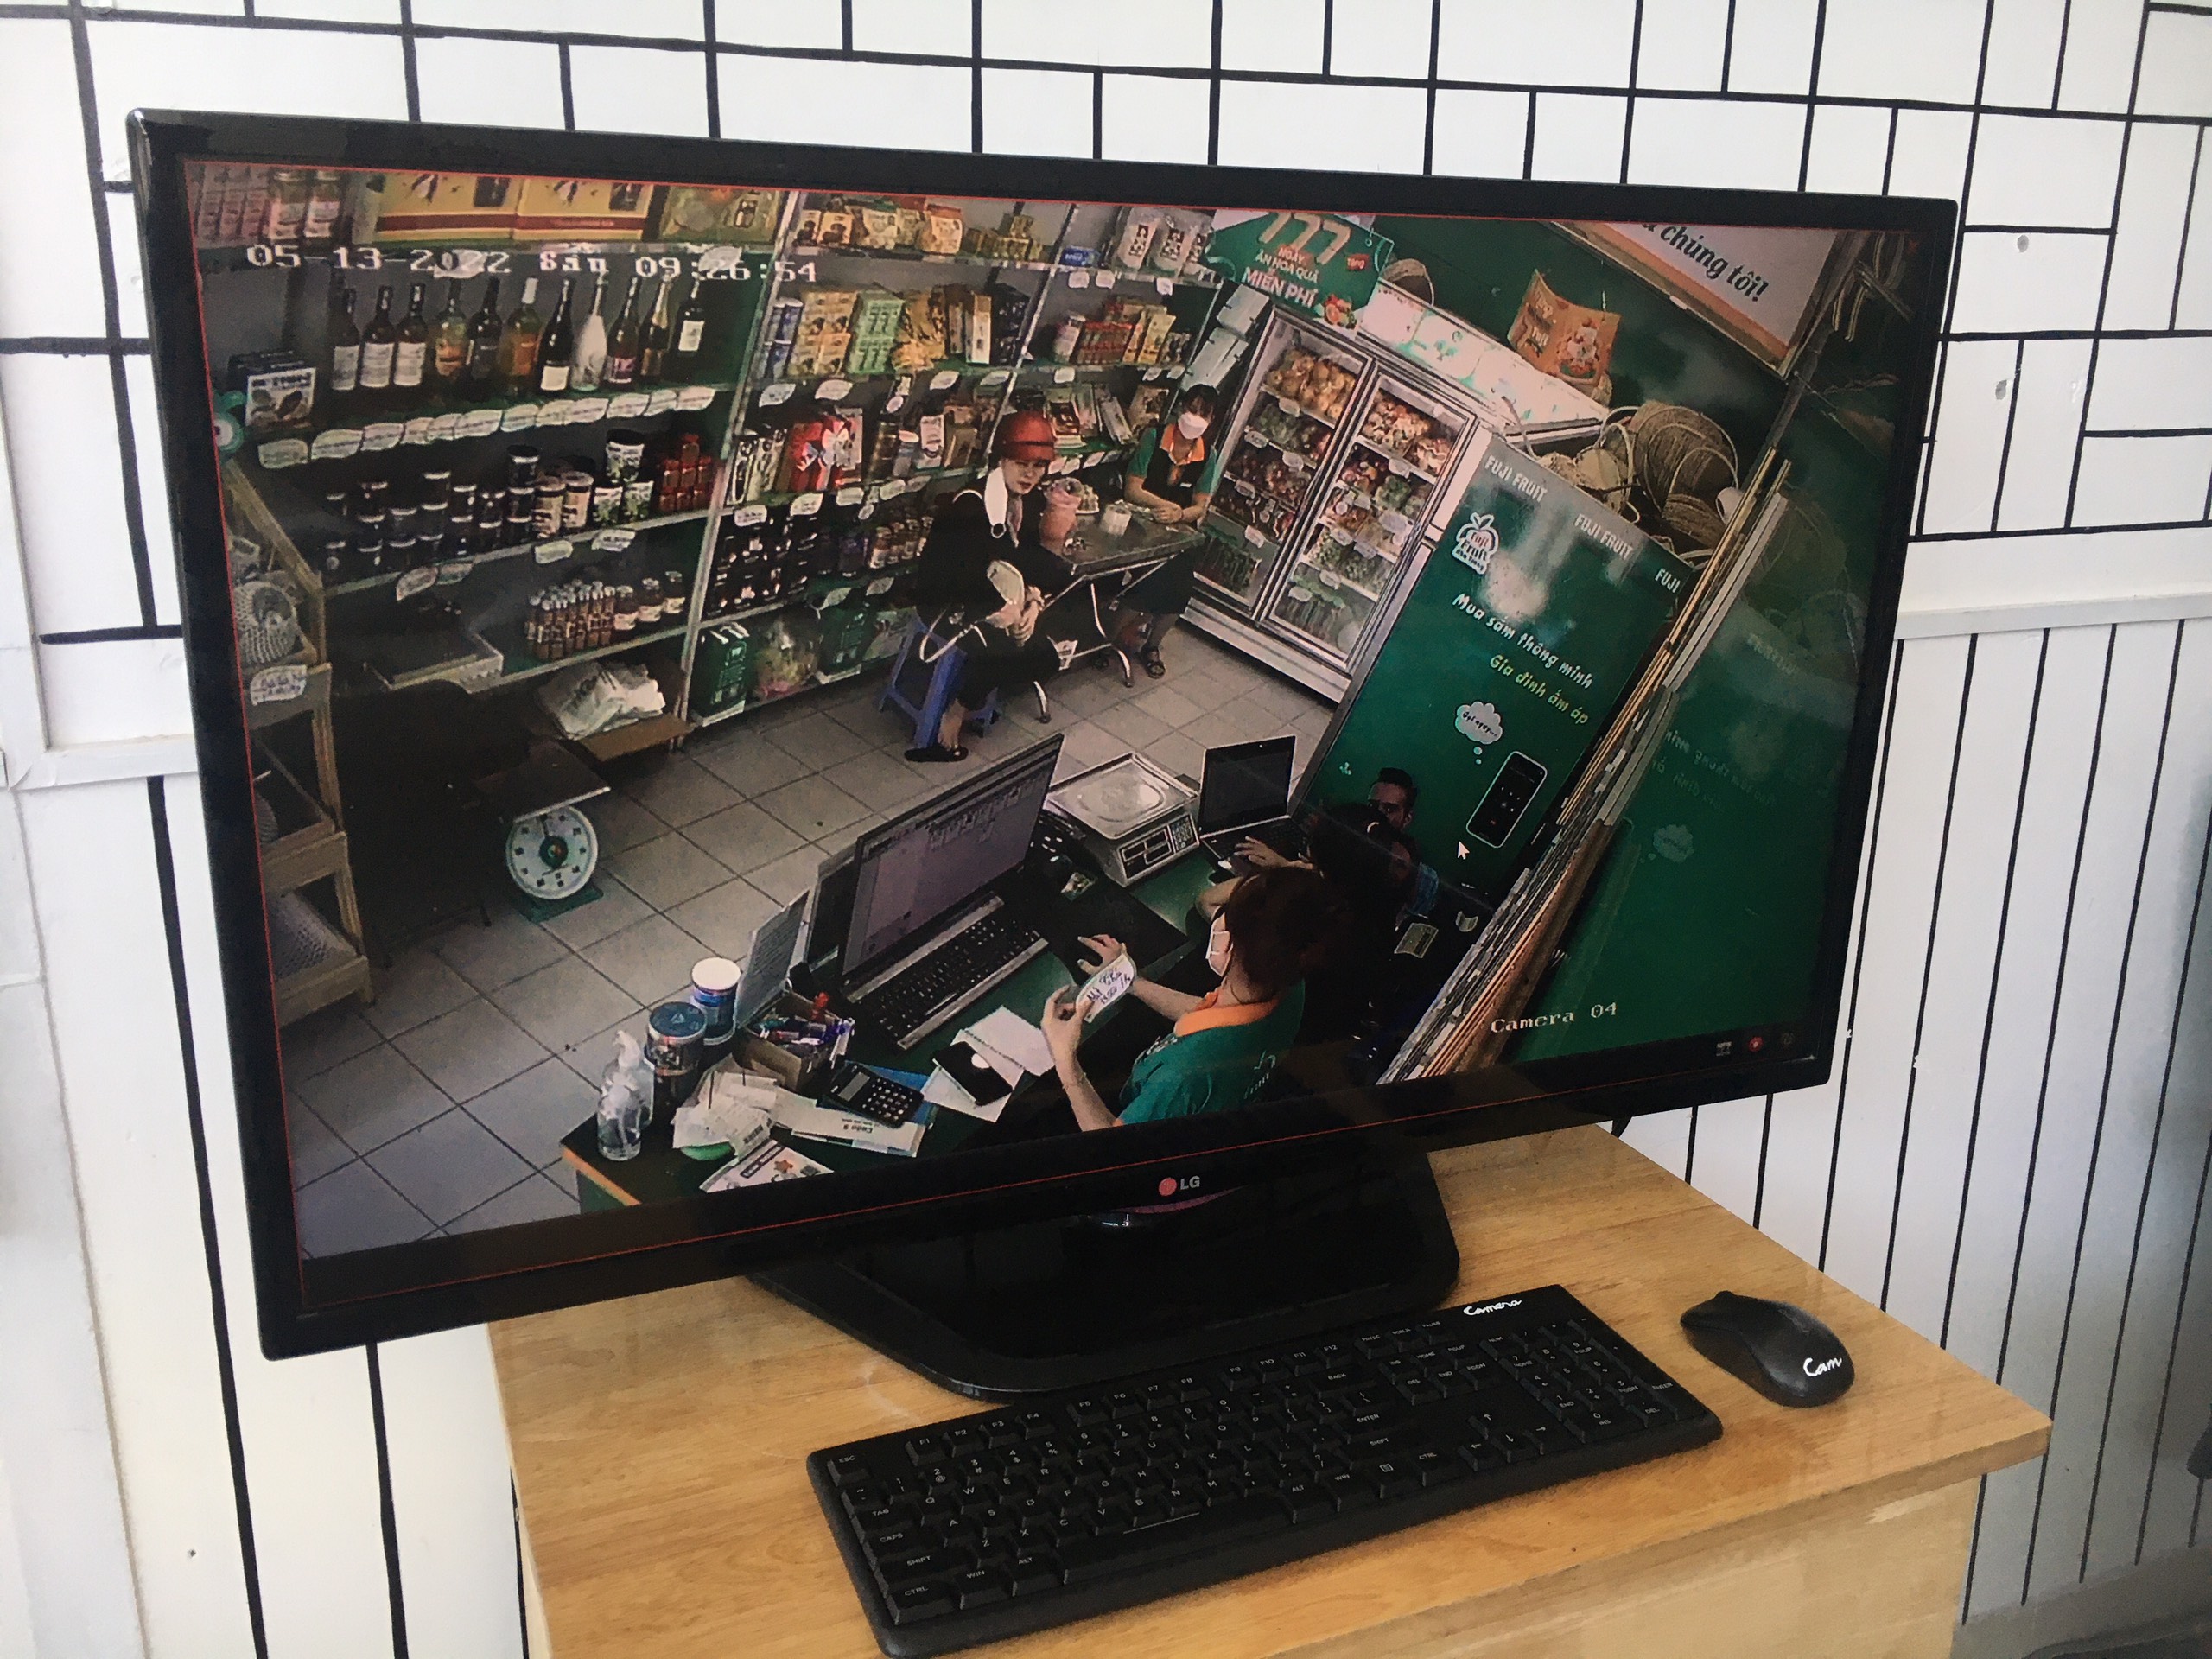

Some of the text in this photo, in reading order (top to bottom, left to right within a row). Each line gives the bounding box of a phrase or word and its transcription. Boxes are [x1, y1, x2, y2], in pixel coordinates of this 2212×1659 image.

[1660, 225, 1769, 302] chúng tôi!
[1484, 454, 1681, 594] FUJI FRUIT FUJI FRUIT FUJI
[1452, 592, 1485, 620] Mua
[1516, 632, 1559, 670] thông
[1489, 653, 1514, 678] Gia
[1516, 670, 1547, 698] đình
[1491, 1001, 1618, 1034] Camera 04
[1179, 1175, 1201, 1191] LG
[1463, 1299, 1523, 1316] Camera
[1324, 1344, 1338, 1352] F12
[1294, 1351, 1306, 1359] F11
[1260, 1357, 1274, 1366] F10
[1802, 1357, 1843, 1377] Cam
[1147, 1384, 1159, 1393] F7
[1356, 1413, 1380, 1424] ENTER
[954, 1428, 967, 1437] F2
[919, 1437, 931, 1446] F1
[838, 1454, 856, 1464] ESC
[1418, 1451, 1438, 1460] CTRL
[1333, 1472, 1351, 1482] WIN
[963, 1486, 975, 1496] W
[950, 1518, 959, 1527] A
[880, 1532, 904, 1543] CAPS
[1020, 1528, 1030, 1537] X
[981, 1539, 990, 1548] Z
[906, 1554, 932, 1567] SHIFT
[1018, 1556, 1033, 1565] ALT
[966, 1569, 986, 1580] WIN
[904, 1585, 930, 1597] CTRL
